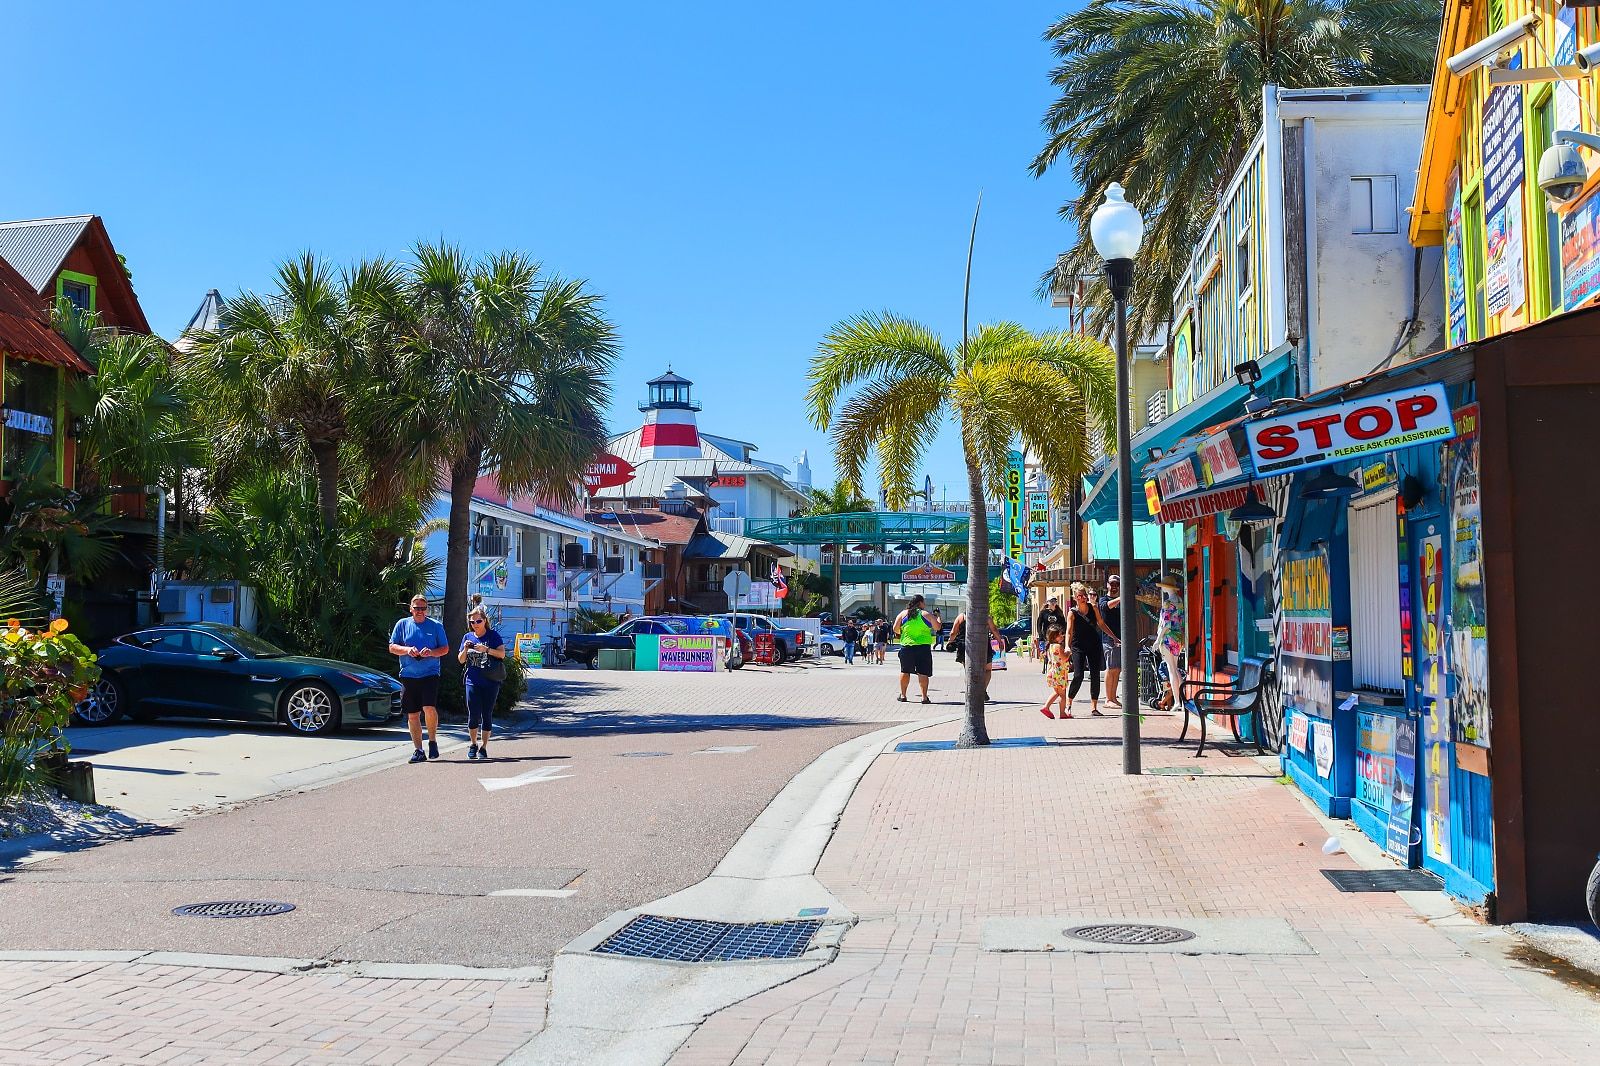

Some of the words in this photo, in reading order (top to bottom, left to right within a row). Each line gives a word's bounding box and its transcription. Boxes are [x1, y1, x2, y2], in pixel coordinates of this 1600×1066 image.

[1256, 394, 1438, 460] STOP
[1334, 444, 1366, 457] PLEASE
[1366, 441, 1383, 451] ASK
[1384, 437, 1401, 448] FOR
[1401, 426, 1450, 443] ASSISTANCE
[1030, 493, 1047, 501] John's
[1198, 484, 1267, 515] INFORMATON
[1030, 511, 1048, 523] GRILLE
[1307, 556, 1330, 609] SHOW
[661, 651, 714, 662] WAVERUNNERS
[1425, 542, 1442, 856] PARASAIL
[1356, 751, 1395, 787] TICKET
[1362, 781, 1385, 806] BOOTH
